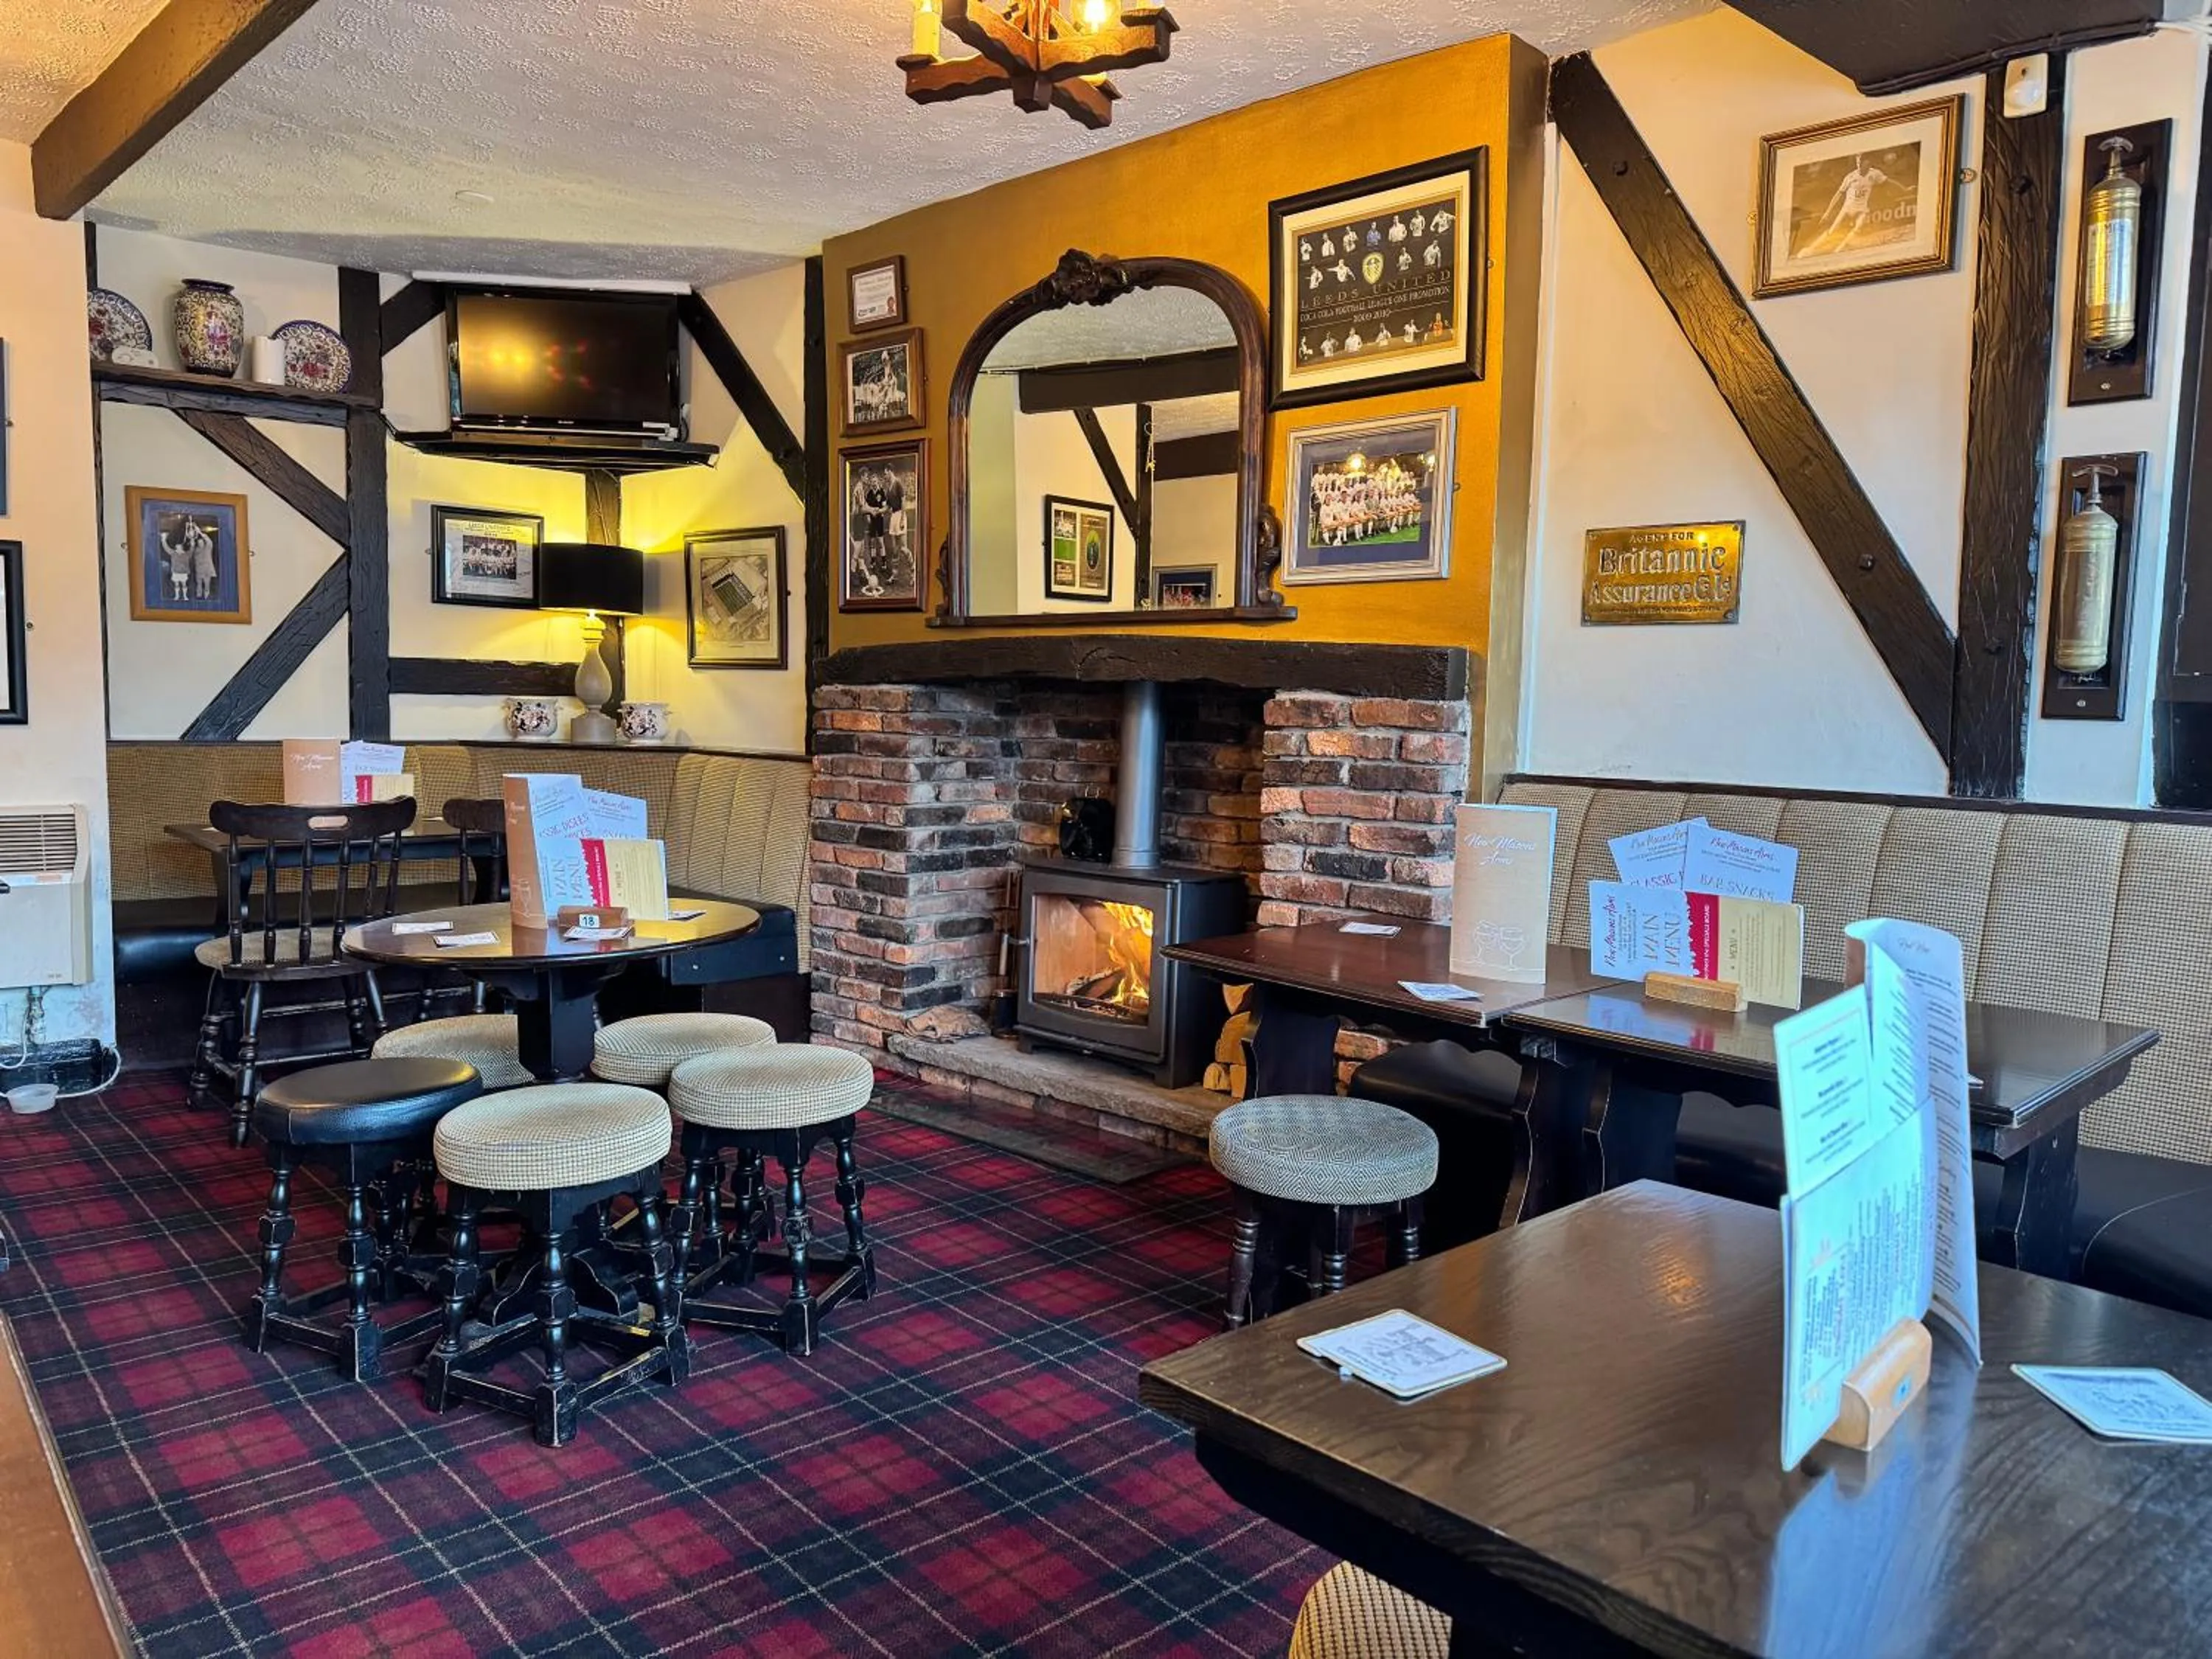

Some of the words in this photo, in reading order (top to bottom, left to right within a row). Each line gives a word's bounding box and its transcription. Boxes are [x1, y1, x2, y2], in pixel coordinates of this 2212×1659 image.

[1301, 288, 1358, 309] LEEDS
[1372, 269, 1450, 294] UNITED
[1628, 533, 1667, 543] AGENT
[1669, 531, 1694, 540] FOR
[1599, 543, 1727, 576] Britannic
[1588, 579, 1691, 604] Assurance
[582, 917, 595, 926] 18
[1643, 912, 1659, 962] MAIN
[1663, 911, 1681, 968] MENU
